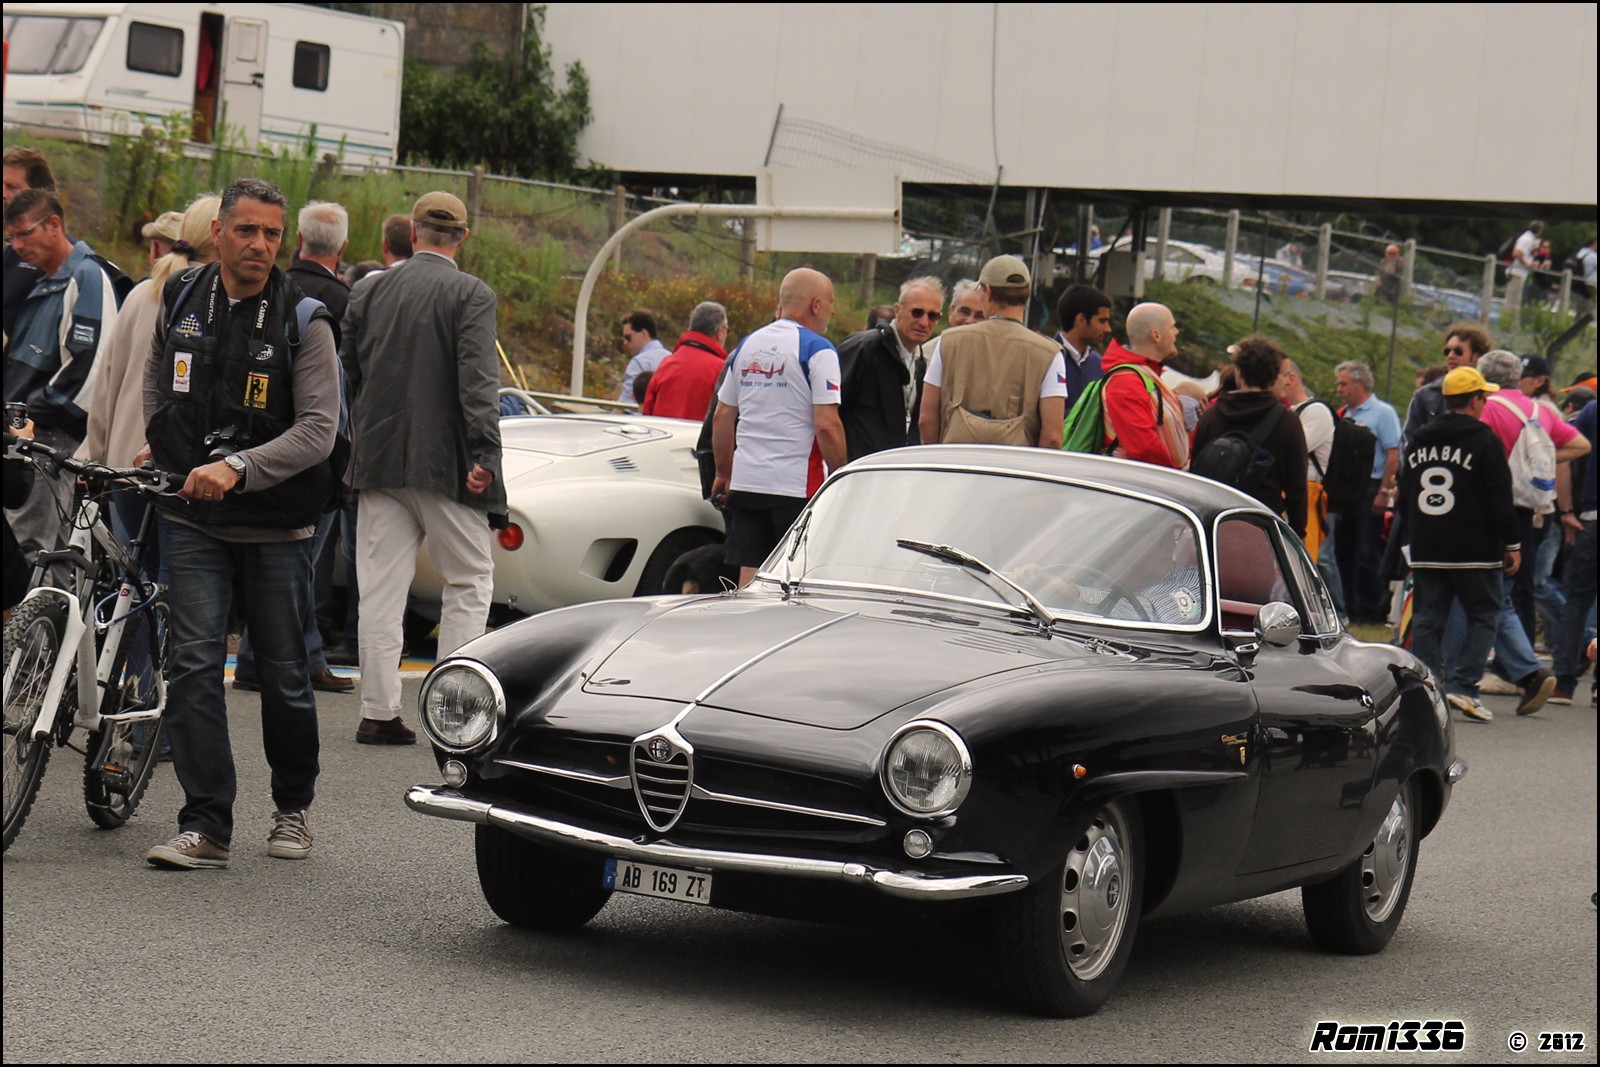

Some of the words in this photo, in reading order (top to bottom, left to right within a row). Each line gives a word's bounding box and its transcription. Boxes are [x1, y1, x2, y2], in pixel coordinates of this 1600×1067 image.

[207, 292, 216, 324] DIGITAL
[256, 299, 269, 329] Canon
[1408, 445, 1473, 471] CHABAL
[1417, 466, 1455, 516] 8
[622, 866, 641, 889] AB
[652, 870, 678, 894] 169
[685, 875, 706, 898] ZT
